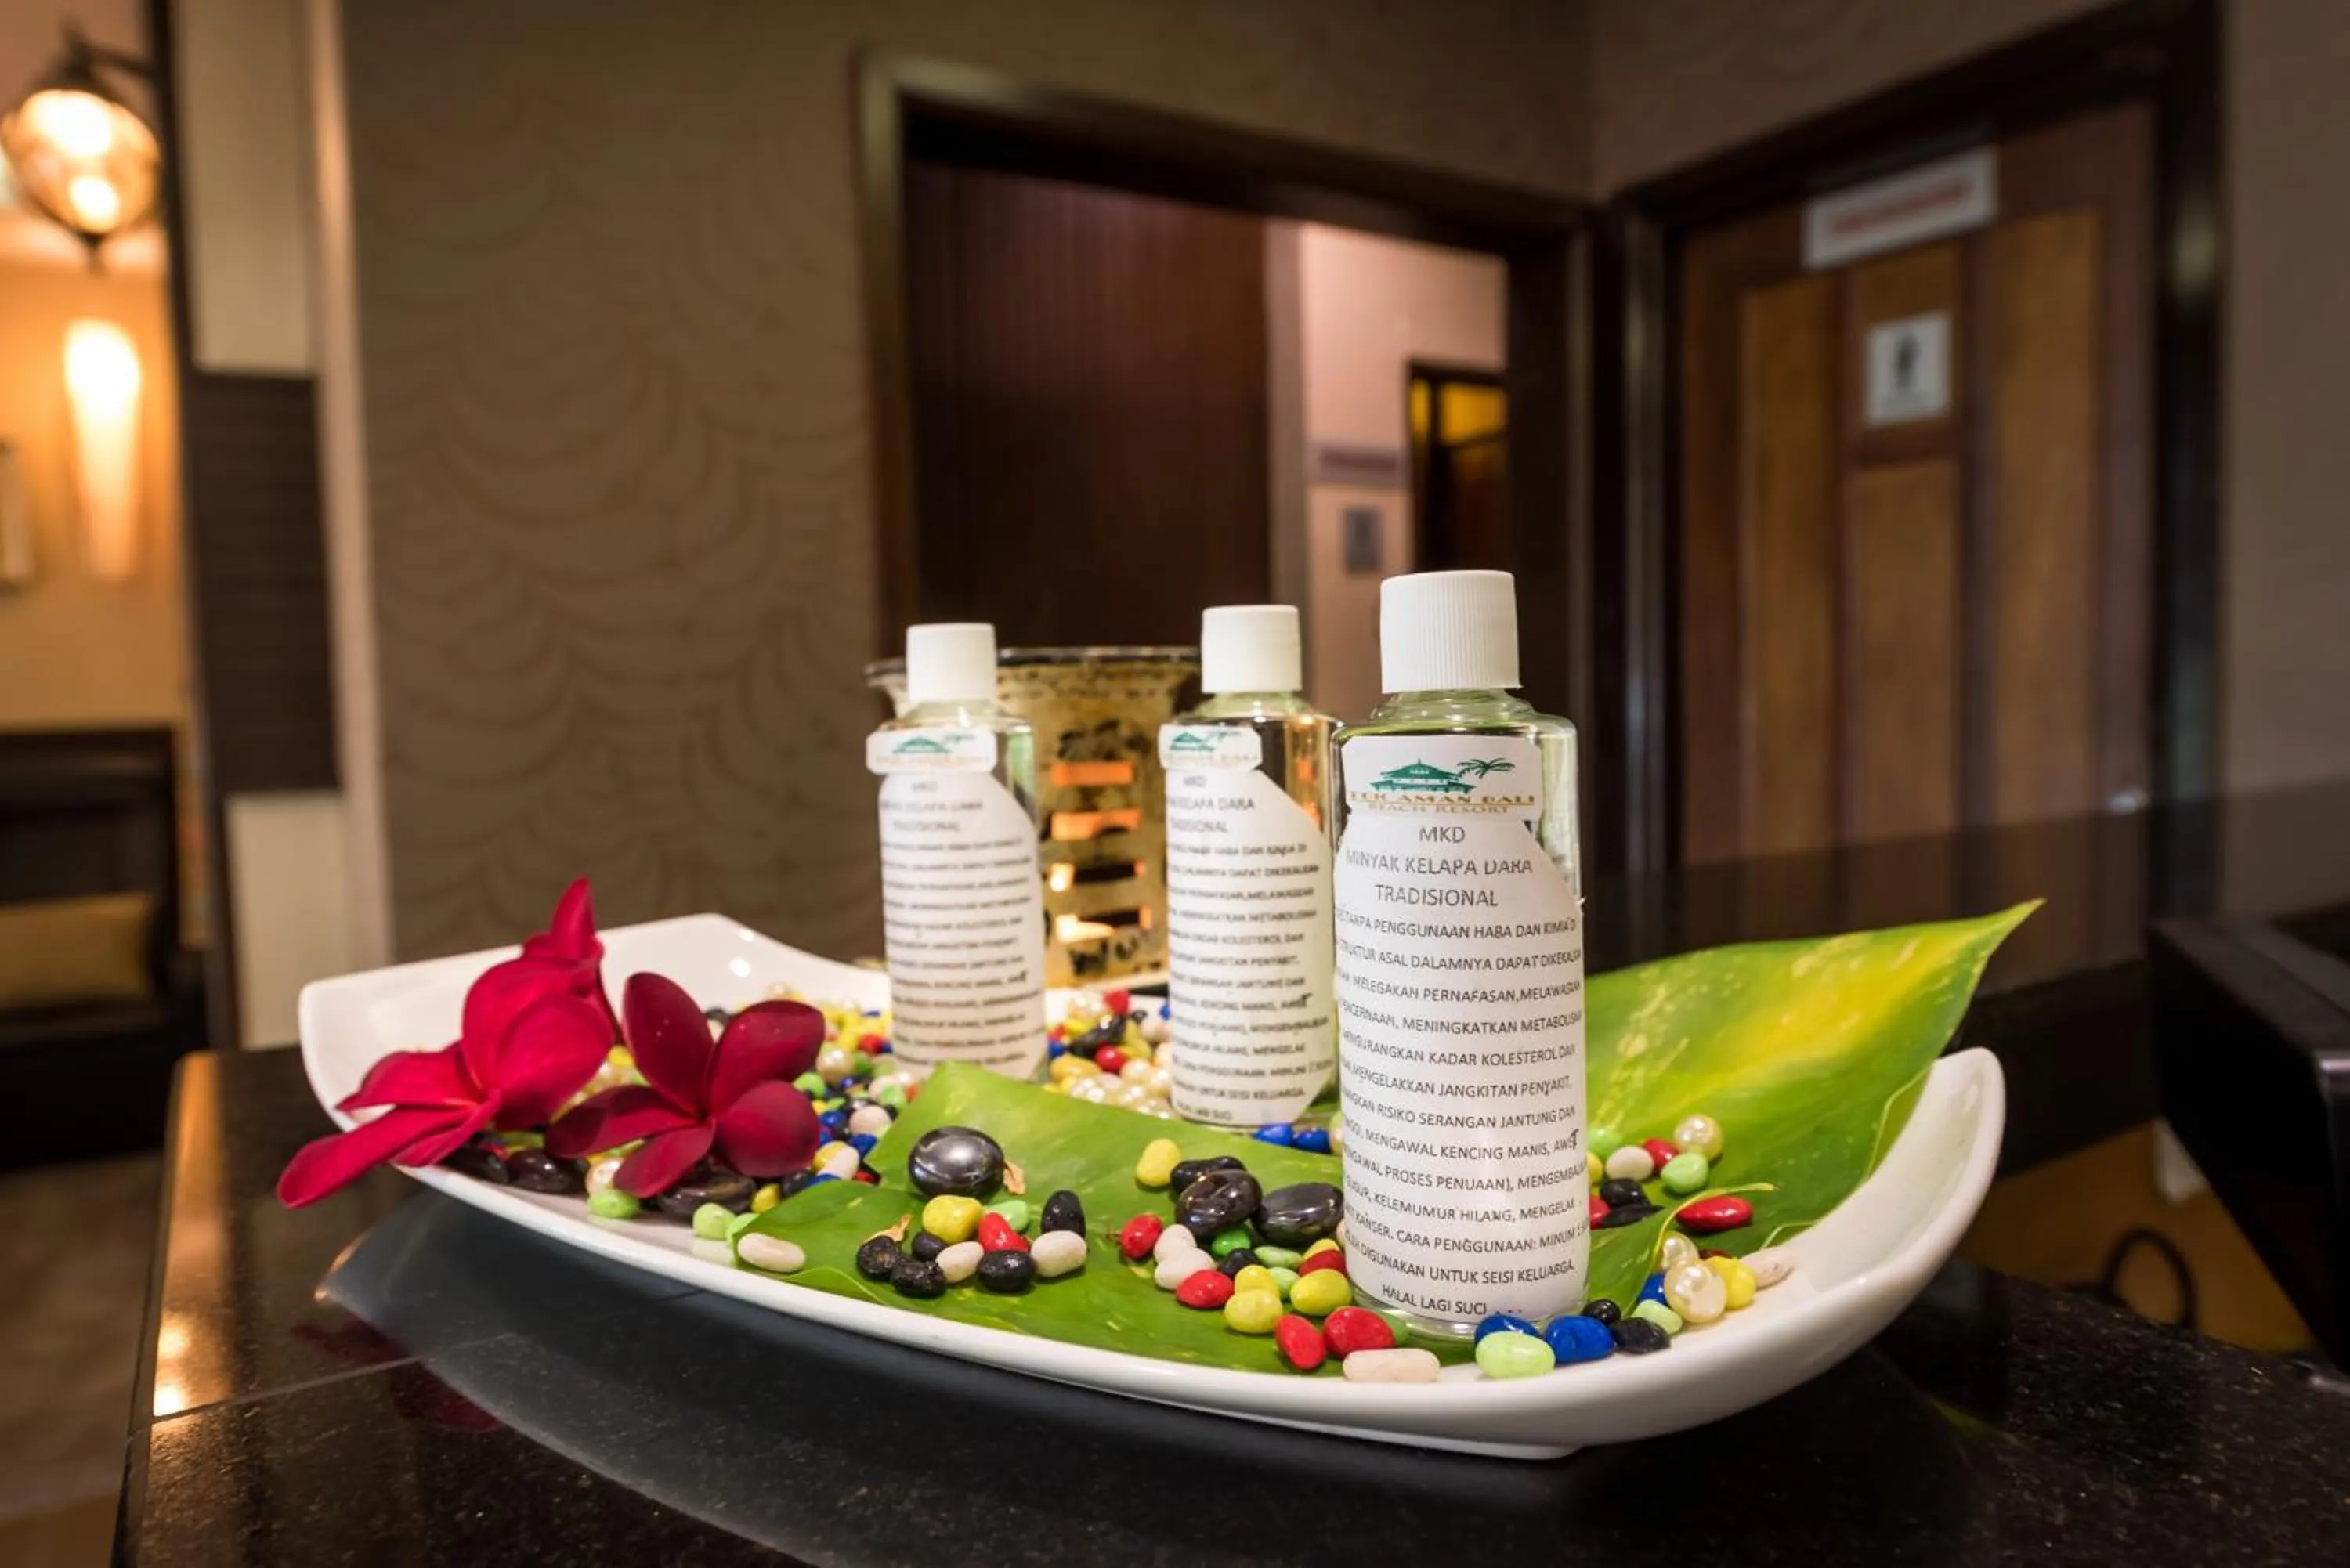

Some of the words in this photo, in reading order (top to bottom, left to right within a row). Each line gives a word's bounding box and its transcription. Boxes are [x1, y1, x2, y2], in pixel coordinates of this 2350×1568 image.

[1396, 793, 1470, 804] AMAN
[1481, 794, 1535, 804] BALI
[1436, 805, 1509, 814] RESORT
[1419, 826, 1466, 844] MKD
[1346, 847, 1401, 873] MINYAK
[1405, 857, 1477, 876] KELAPA
[1484, 858, 1534, 876] DARA
[1375, 884, 1499, 907] TRADISIONAL
[1374, 919, 1470, 938] PENGGUNAAN
[1474, 925, 1512, 939] HABA
[1516, 923, 1541, 938] DAN
[1378, 952, 1408, 967] ASAL
[1411, 955, 1491, 970] DALAMNYA
[1495, 955, 1539, 970] DAPAT
[1353, 976, 1419, 999] MELEGAKAN
[1403, 1017, 1517, 1035] MENINGKATKAN
[1428, 1053, 1477, 1066] KADAR
[1481, 1047, 1558, 1066] KOLESTEROL
[1437, 1082, 1517, 1097] JANGKITAN
[1377, 1104, 1415, 1123] RISIKO
[1419, 1112, 1497, 1129] SERANGAN
[1500, 1109, 1556, 1129] JANTUNG
[1558, 1105, 1576, 1122] DAN
[1365, 1129, 1437, 1158] MENGAWAL
[1441, 1145, 1503, 1160] KENCING
[1508, 1142, 1550, 1158] MANIS,
[1385, 1165, 1433, 1188] PROSES
[1374, 1191, 1455, 1220] KELEMUMUR
[1460, 1209, 1516, 1223] HILANG,
[1397, 1230, 1430, 1249] CARA
[1434, 1237, 1536, 1254] PENGGUNAAN:
[1361, 1242, 1425, 1278] DIGUNAKAN
[1430, 1266, 1478, 1284] UNTUK
[1482, 1269, 1514, 1284] SEISI
[1383, 1284, 1417, 1307] HALAL
[1421, 1296, 1452, 1312] LAGI
[1455, 1301, 1487, 1315] SUCI
